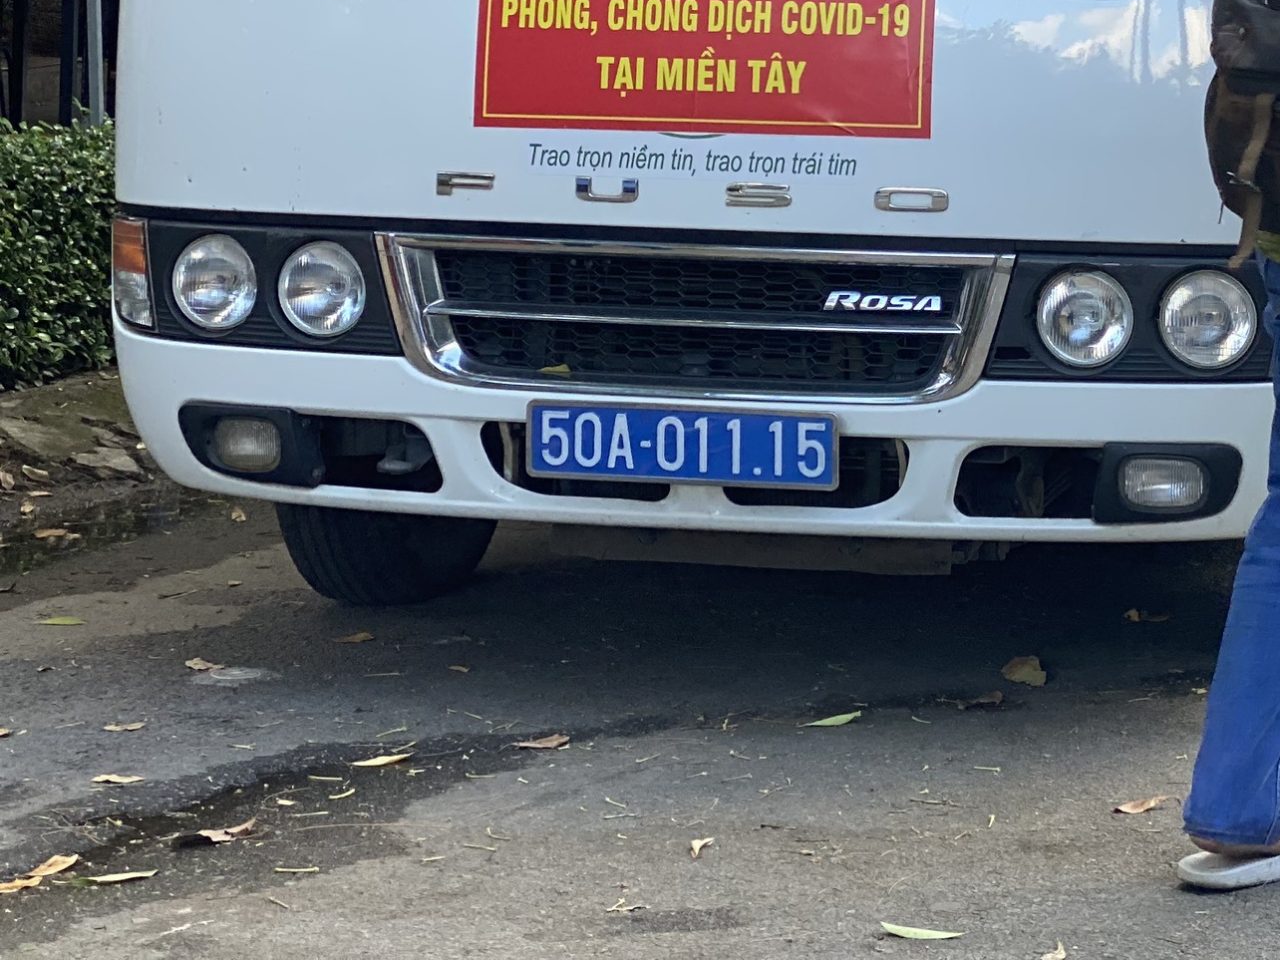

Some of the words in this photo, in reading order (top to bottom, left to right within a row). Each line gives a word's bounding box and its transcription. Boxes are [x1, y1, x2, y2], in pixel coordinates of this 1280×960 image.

[708, 0, 772, 41] DỊCH
[781, 0, 911, 38] COVID-19
[596, 56, 645, 98] TẠI
[656, 46, 737, 93] MIỀN
[747, 52, 807, 95] TÂY
[529, 143, 571, 167] Trao
[576, 146, 613, 172] trọn
[618, 144, 665, 170] niềm
[671, 148, 697, 177] tin,
[705, 149, 743, 173] trao
[748, 151, 786, 177] trọn
[791, 152, 824, 175] trái
[828, 153, 858, 176] tim
[436, 170, 950, 213] FUSO
[541, 409, 826, 479] 50A-011.15
